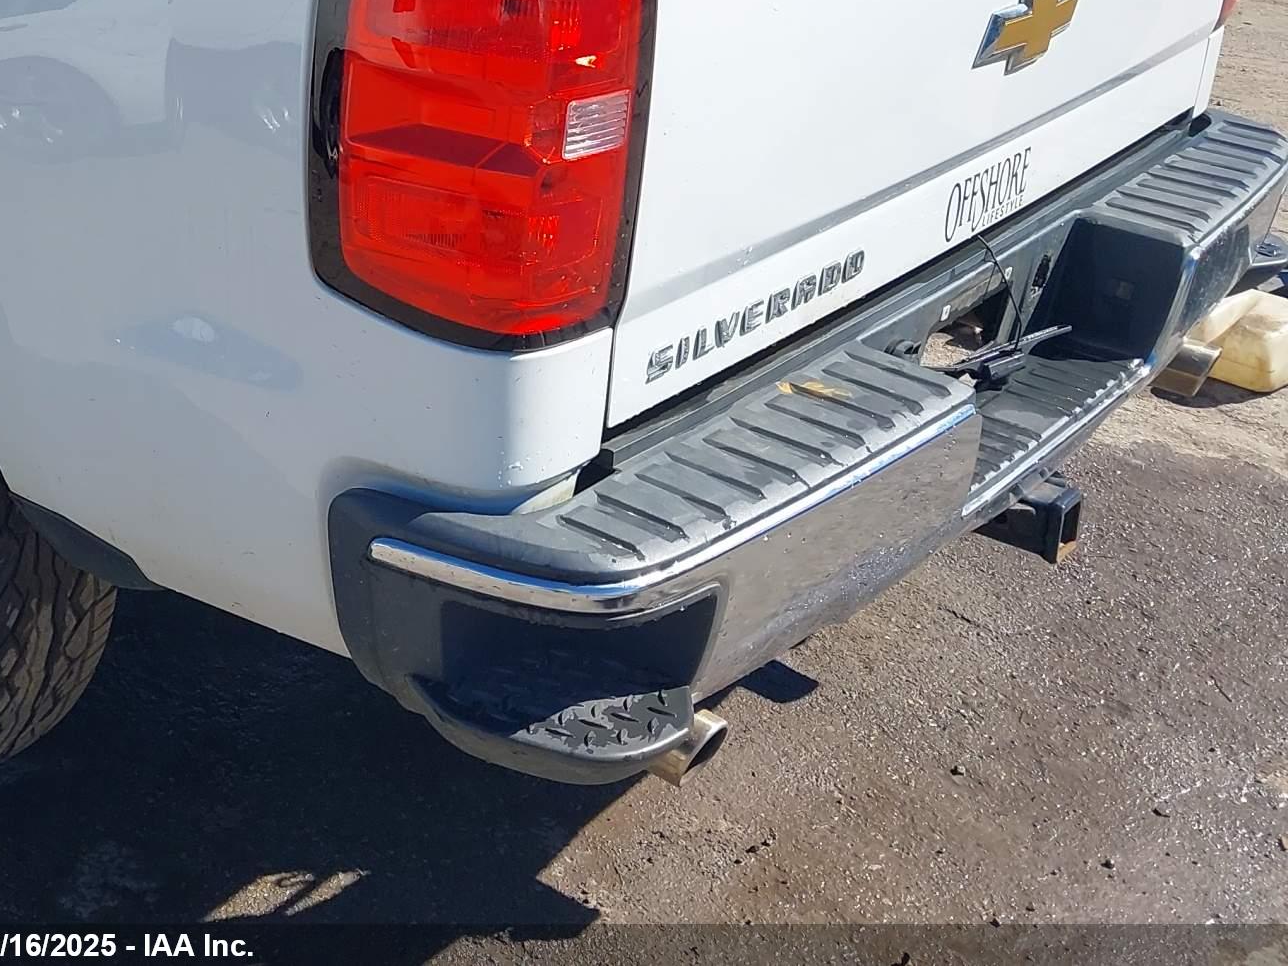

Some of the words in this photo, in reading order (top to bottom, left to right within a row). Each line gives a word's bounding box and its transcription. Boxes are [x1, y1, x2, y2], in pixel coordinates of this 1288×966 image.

[944, 146, 1032, 242] OFFSHORE
[982, 194, 1024, 227] LIFESTYLE
[645, 249, 865, 384] SILVERADO
